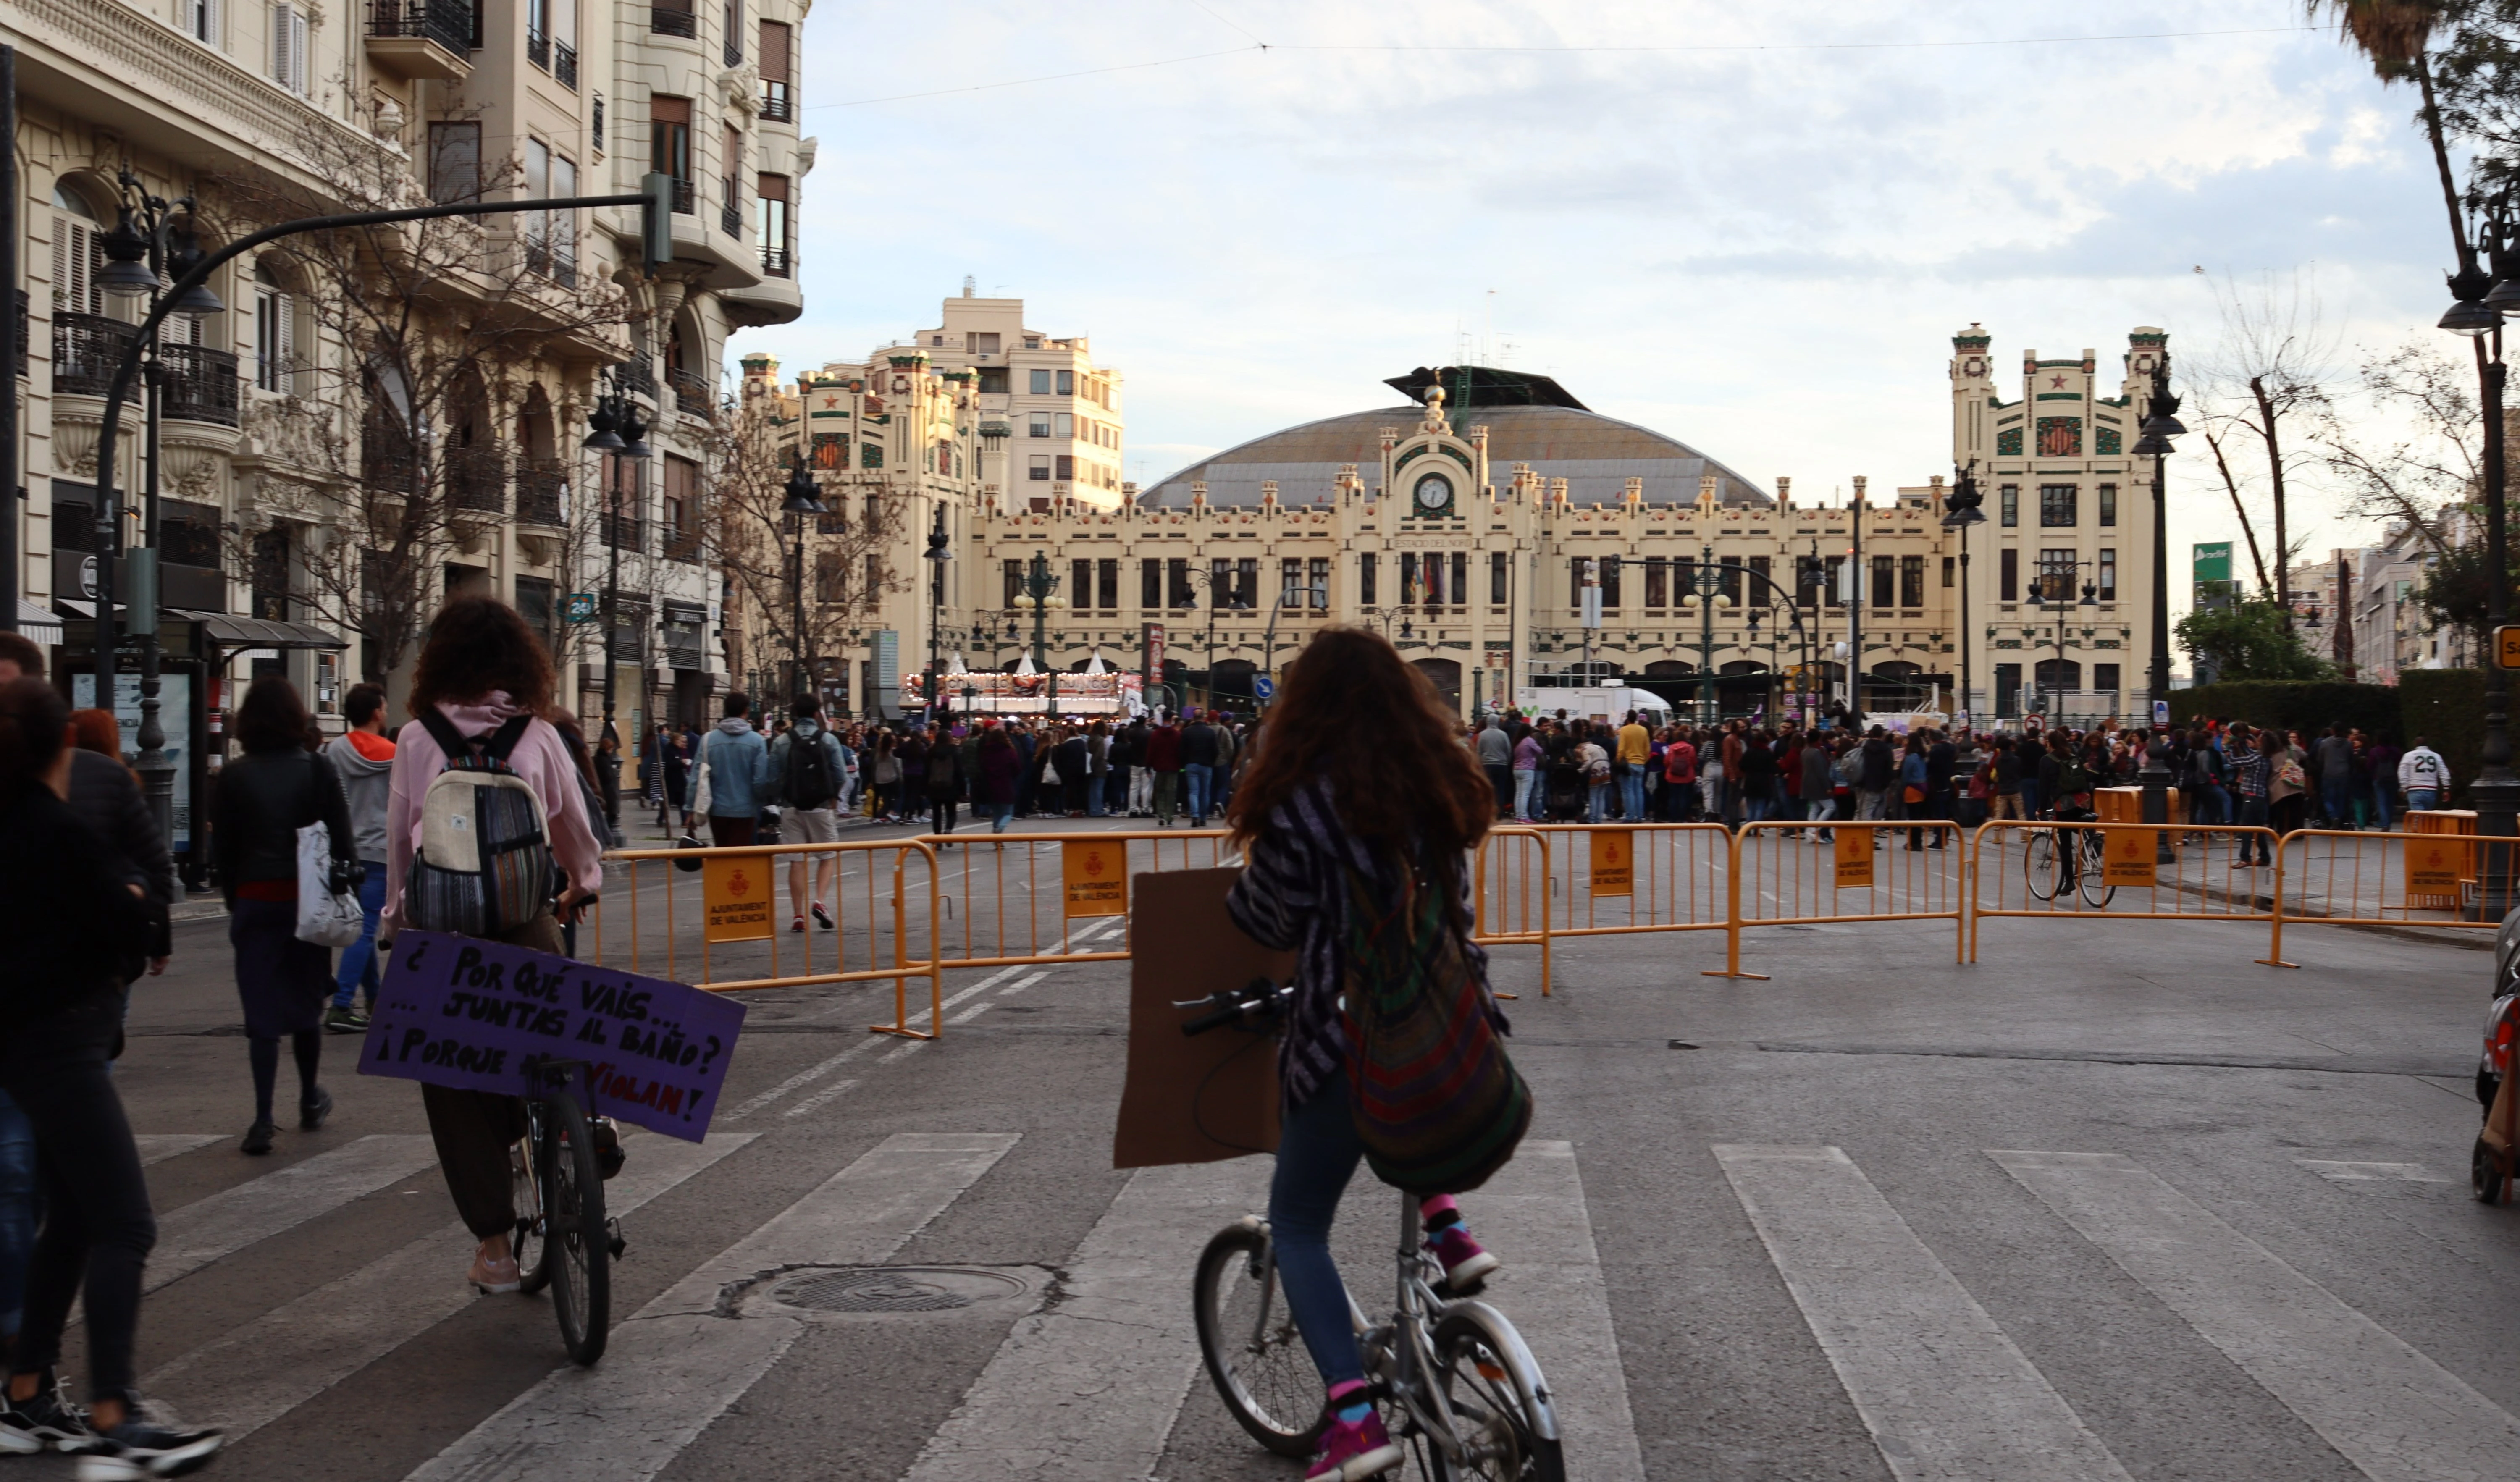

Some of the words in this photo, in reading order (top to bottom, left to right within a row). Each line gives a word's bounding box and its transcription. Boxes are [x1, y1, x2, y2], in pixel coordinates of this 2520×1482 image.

[2414, 755, 2436, 773] 29
[1069, 881, 1120, 891] AJUNTAMENT
[711, 902, 767, 913] AJUNTAMENT
[711, 917, 722, 925] DE
[442, 991, 568, 1037] JUNTAS
[575, 1018, 606, 1045] AL
[619, 1026, 720, 1075] BAÑO?
